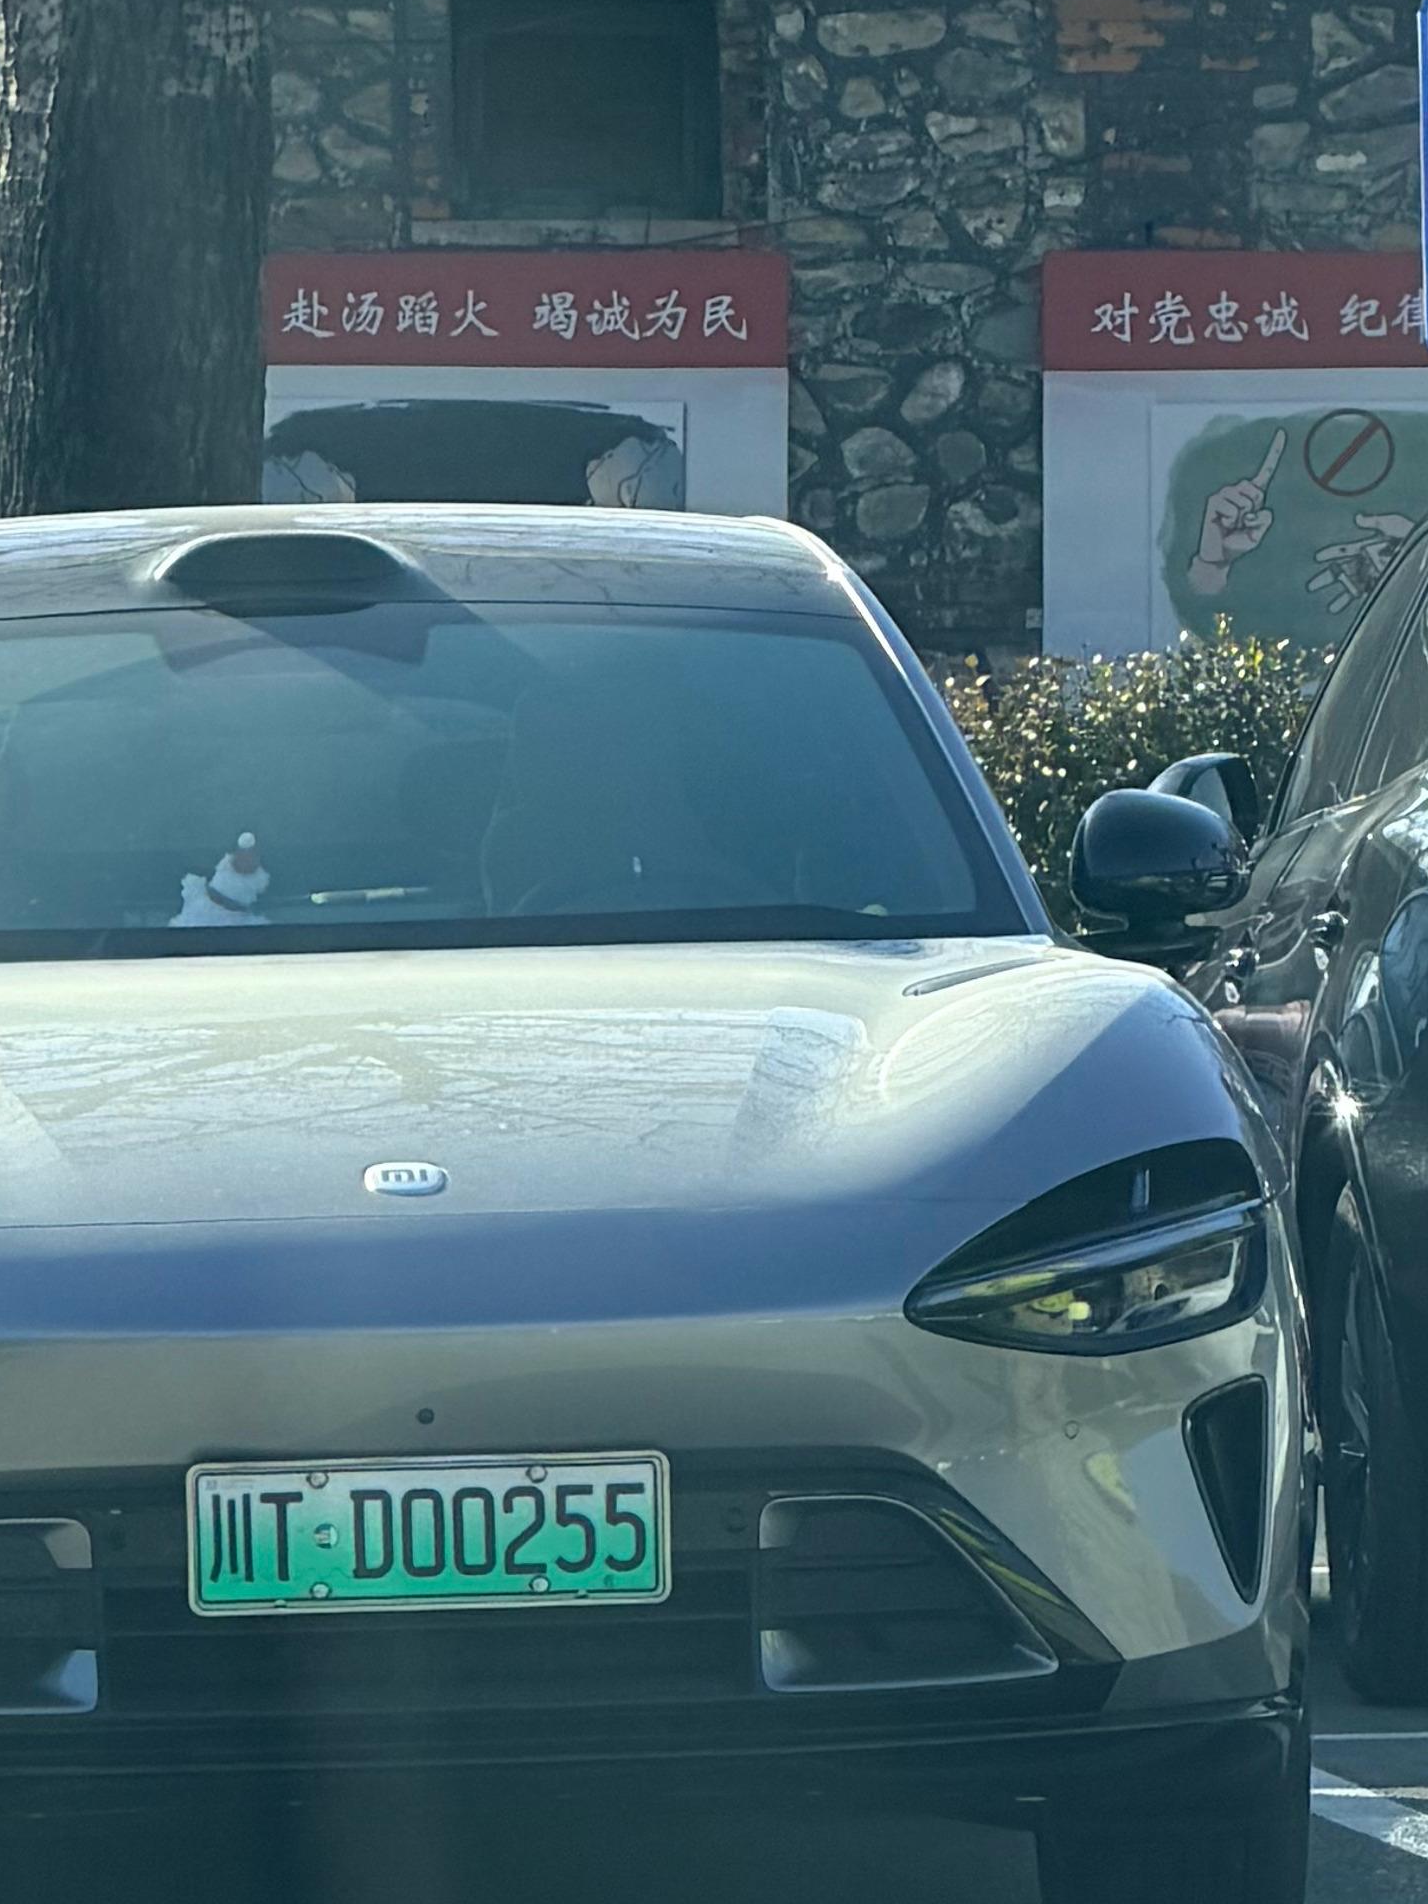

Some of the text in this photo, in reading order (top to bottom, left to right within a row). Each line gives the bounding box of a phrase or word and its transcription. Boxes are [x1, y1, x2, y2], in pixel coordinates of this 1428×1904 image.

[281, 288, 749, 342] 赴汤蹈火 竭诚为民
[1090, 289, 1310, 345] 对党忠诚
